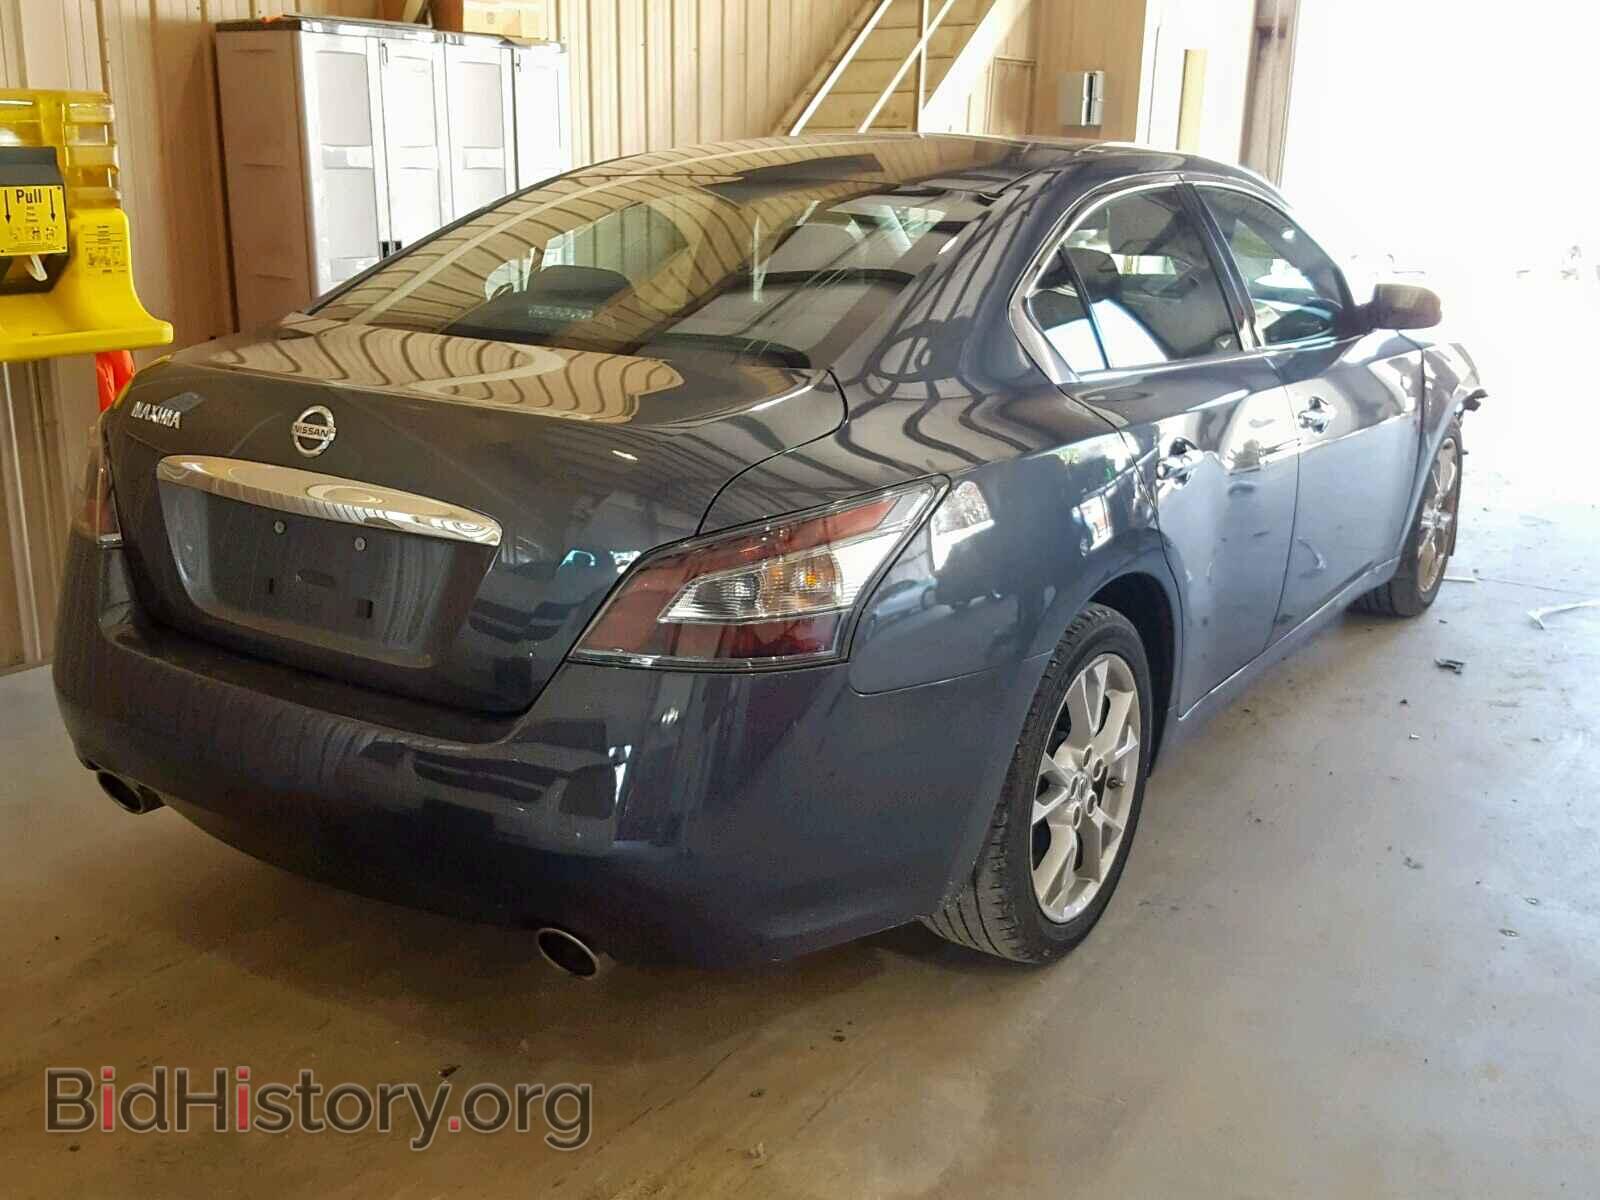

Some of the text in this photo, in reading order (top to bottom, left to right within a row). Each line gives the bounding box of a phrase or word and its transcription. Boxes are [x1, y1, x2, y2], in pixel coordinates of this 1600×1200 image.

[16, 189, 42, 204] Pull
[131, 401, 180, 429] MAXIMA
[295, 424, 329, 438] NISSAN
